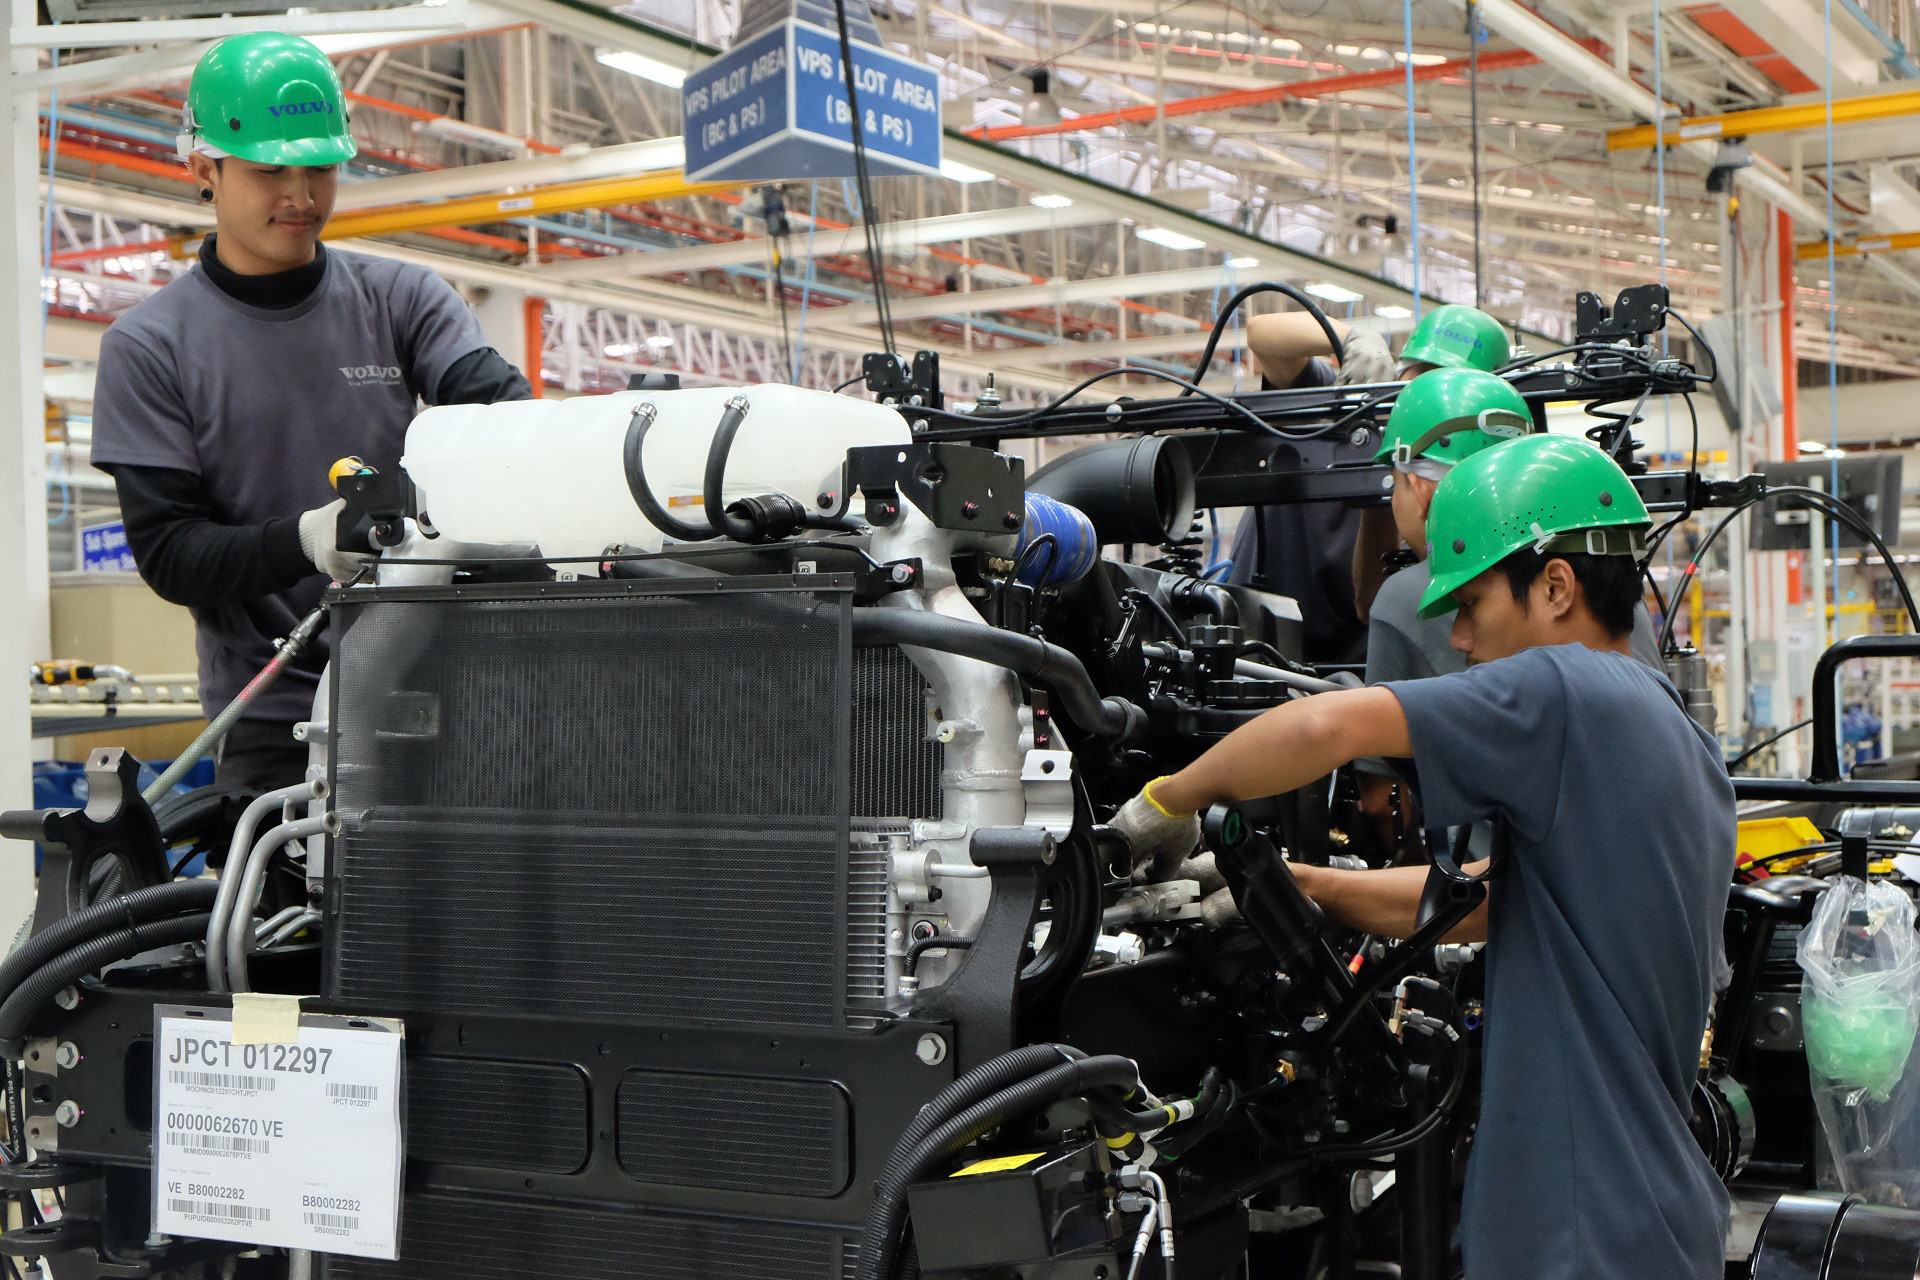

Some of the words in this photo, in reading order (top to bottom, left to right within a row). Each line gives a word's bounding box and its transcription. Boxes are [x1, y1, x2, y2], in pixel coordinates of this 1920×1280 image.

[684, 86, 709, 116] VPS
[711, 65, 747, 104] PILOT
[750, 46, 786, 84] AREA
[797, 45, 834, 80] VPS
[839, 58, 888, 97] LOT
[892, 77, 936, 114] AREA
[267, 100, 334, 118] VOLVO
[729, 113, 739, 136] &
[741, 96, 766, 130] PS)
[865, 108, 878, 134] &
[882, 112, 913, 147] PS)
[338, 364, 402, 379] VOLVO
[168, 1037, 232, 1068] JPCT
[243, 1043, 333, 1075] 012297
[332, 1097, 348, 1106] JPCT
[349, 1098, 371, 1108] 012297
[167, 1111, 258, 1136] 0000062670
[262, 1119, 284, 1138] VE
[167, 1181, 182, 1194] VE
[188, 1183, 245, 1200] B80002282
[302, 1195, 361, 1212] B80002282
